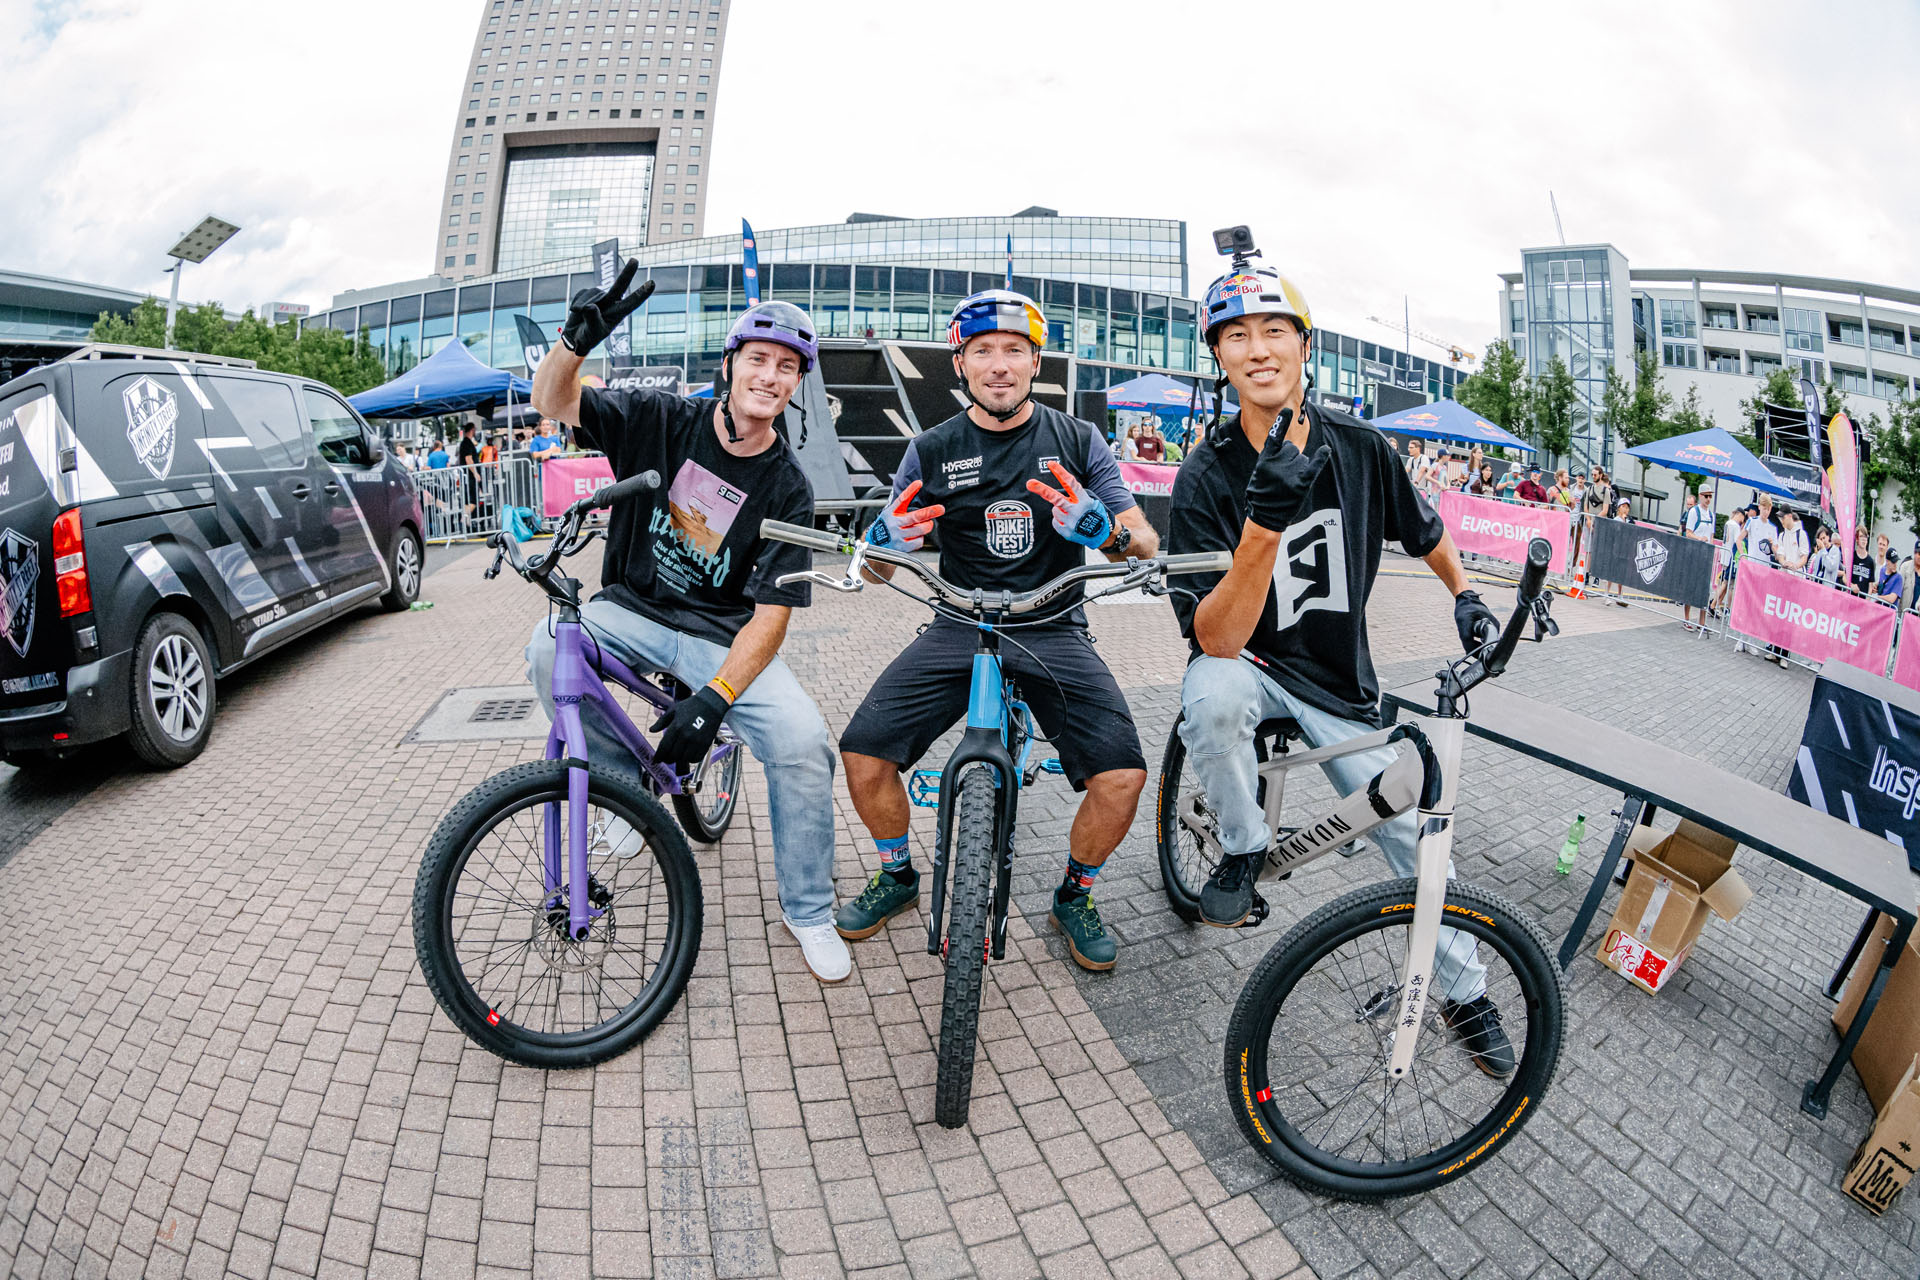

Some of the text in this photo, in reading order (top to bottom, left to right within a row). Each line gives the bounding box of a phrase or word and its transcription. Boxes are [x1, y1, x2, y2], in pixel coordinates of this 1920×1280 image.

[1220, 285, 1263, 300] Red Bull
[156, 399, 178, 433] STREET
[1268, 414, 1283, 438] poc
[1675, 450, 1734, 469] Red Bull
[574, 477, 616, 496] EUR
[995, 518, 1025, 535] BIKE
[1461, 514, 1541, 543] EUROBIKE
[995, 534, 1025, 551] FEST
[919, 573, 950, 599] CLEAN
[1033, 583, 1066, 608] CLEAN
[1764, 593, 1861, 647] EUROBIKE
[1267, 813, 1352, 868] CANYON
[1380, 902, 1496, 928] CONENTAL
[1240, 1047, 1272, 1145] CONTINENTAL
[1437, 1096, 1531, 1177] CONTINENTAL
